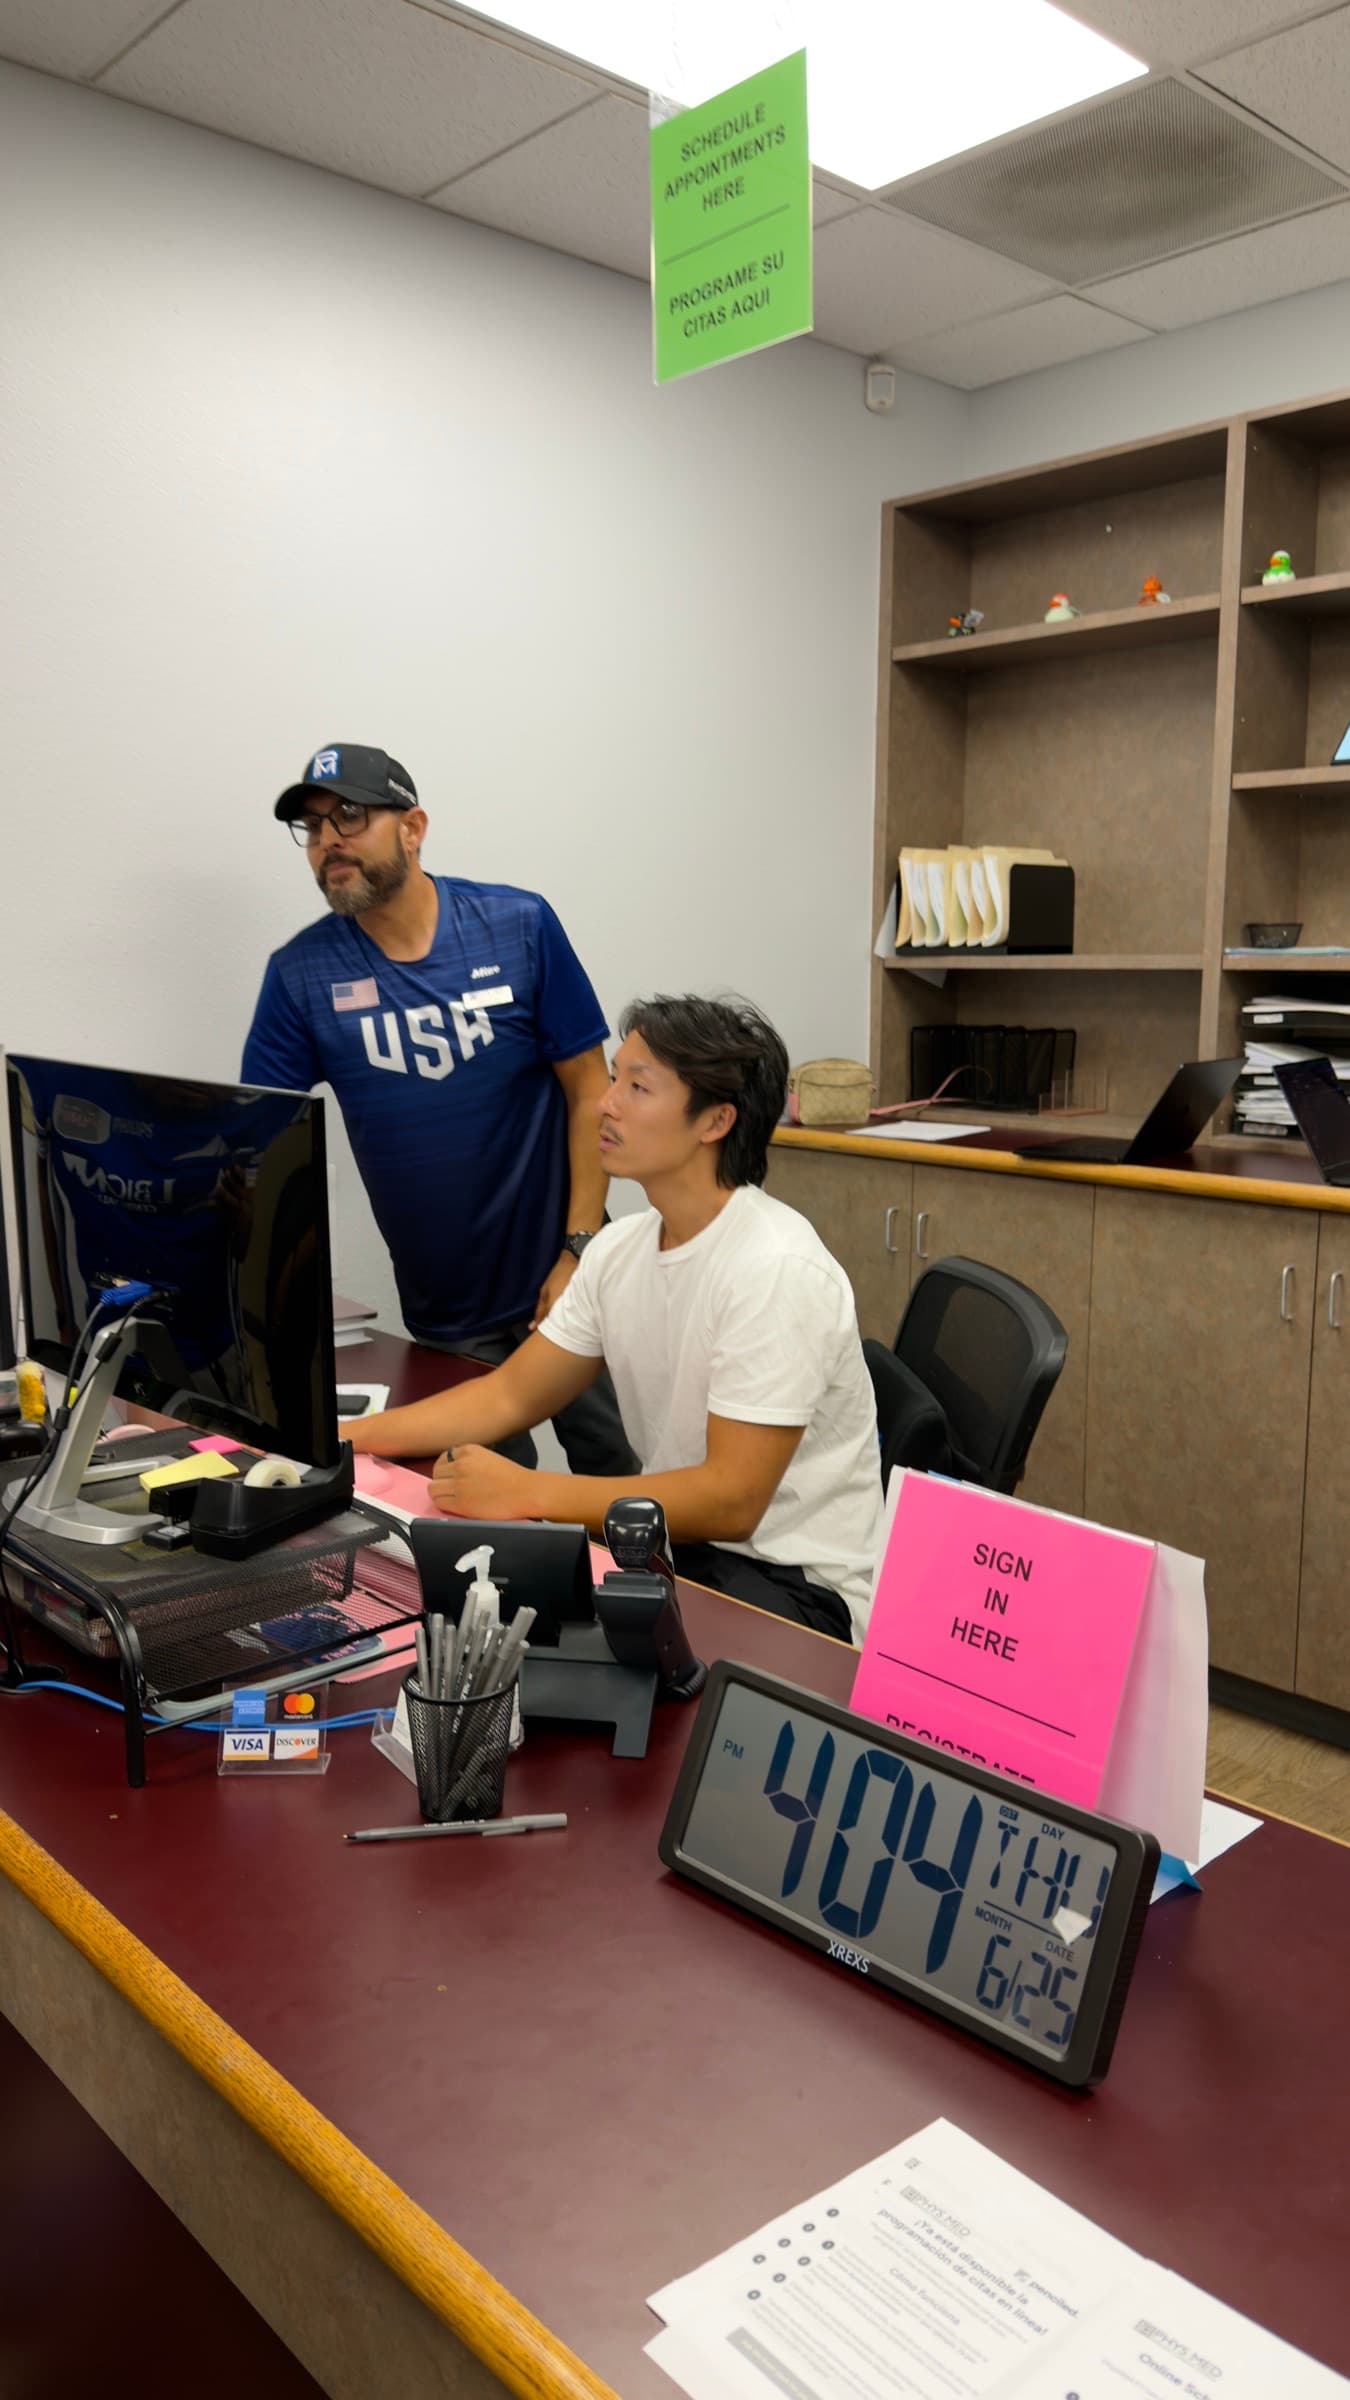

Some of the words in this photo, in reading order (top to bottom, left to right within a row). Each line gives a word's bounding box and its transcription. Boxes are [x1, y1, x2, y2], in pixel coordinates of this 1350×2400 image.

[680, 102, 765, 162] SCHEDULE
[664, 124, 786, 200] APPOINTMENTS
[702, 176, 745, 212] HERE
[669, 261, 757, 315] PROGRAME
[762, 250, 785, 276] SU
[682, 304, 727, 339] CITAS
[731, 287, 770, 320] AQUI
[360, 1001, 495, 1080] USA
[973, 1543, 1033, 1582] SIGN
[983, 1587, 1009, 1615] IN
[950, 1617, 1019, 1662] HERE
[232, 1738, 263, 1751] VISA
[276, 1737, 316, 1747] DISCOVER
[722, 1738, 744, 1760] PM
[1041, 1824, 1065, 1840] DAY
[990, 1821, 1110, 1939] THU
[975, 1906, 1012, 1931] MONTH
[827, 1940, 870, 1973] XREXS
[1046, 1940, 1074, 1962] DATE
[952, 2262, 968, 2278] de
[968, 2275, 997, 2301] citas
[997, 2297, 1013, 2312] en
[958, 2250, 1016, 2297] disponible
[1139, 2353, 1182, 2385] Online
